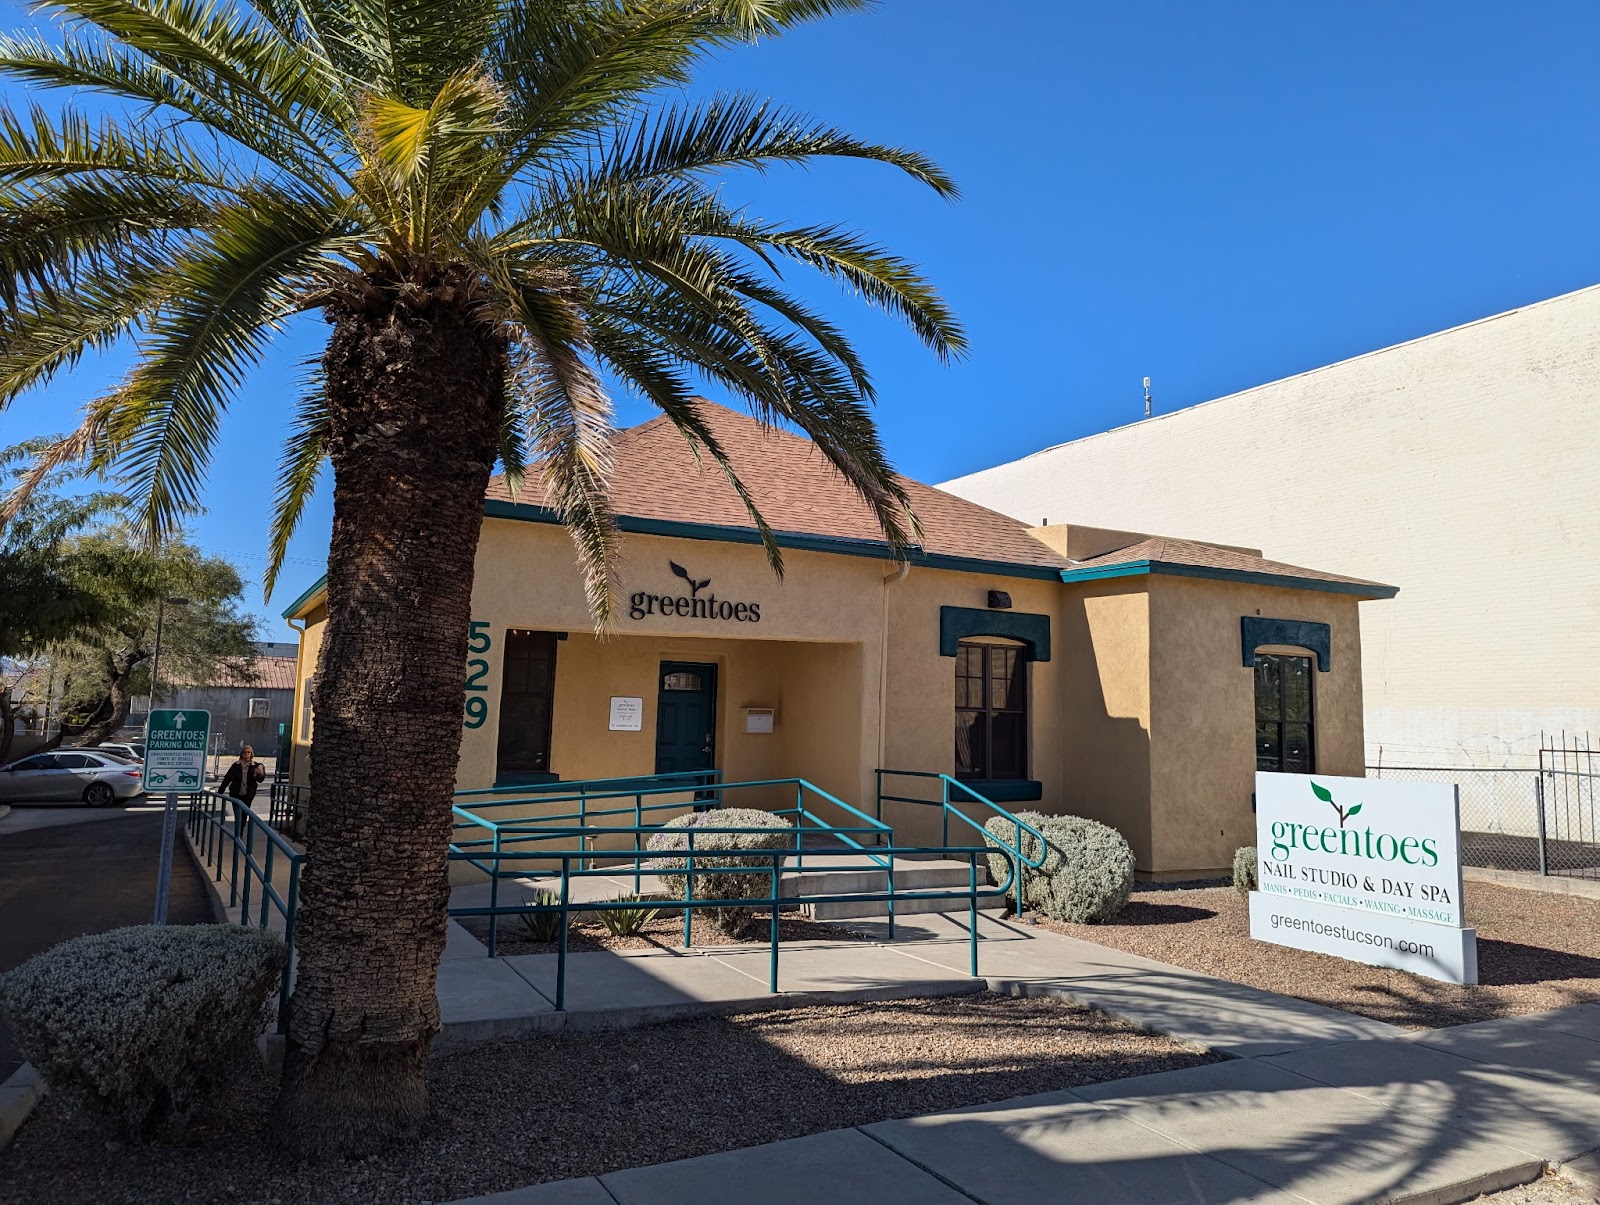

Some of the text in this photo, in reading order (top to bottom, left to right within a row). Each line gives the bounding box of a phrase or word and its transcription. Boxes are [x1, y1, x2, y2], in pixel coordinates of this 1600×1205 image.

[630, 591, 761, 623] greentoes
[464, 621, 492, 729] 529
[149, 741, 204, 749] PARKING ONLY
[150, 730, 205, 740] GREENTOES
[1271, 821, 1438, 867] greentoes
[1263, 860, 1452, 904] NAIL STUDIO & DAY SPA
[1263, 882, 1454, 923] MANIS PEDIS FACIALS WAXING MASSAGE
[1270, 913, 1434, 958] greentoestucson.com
